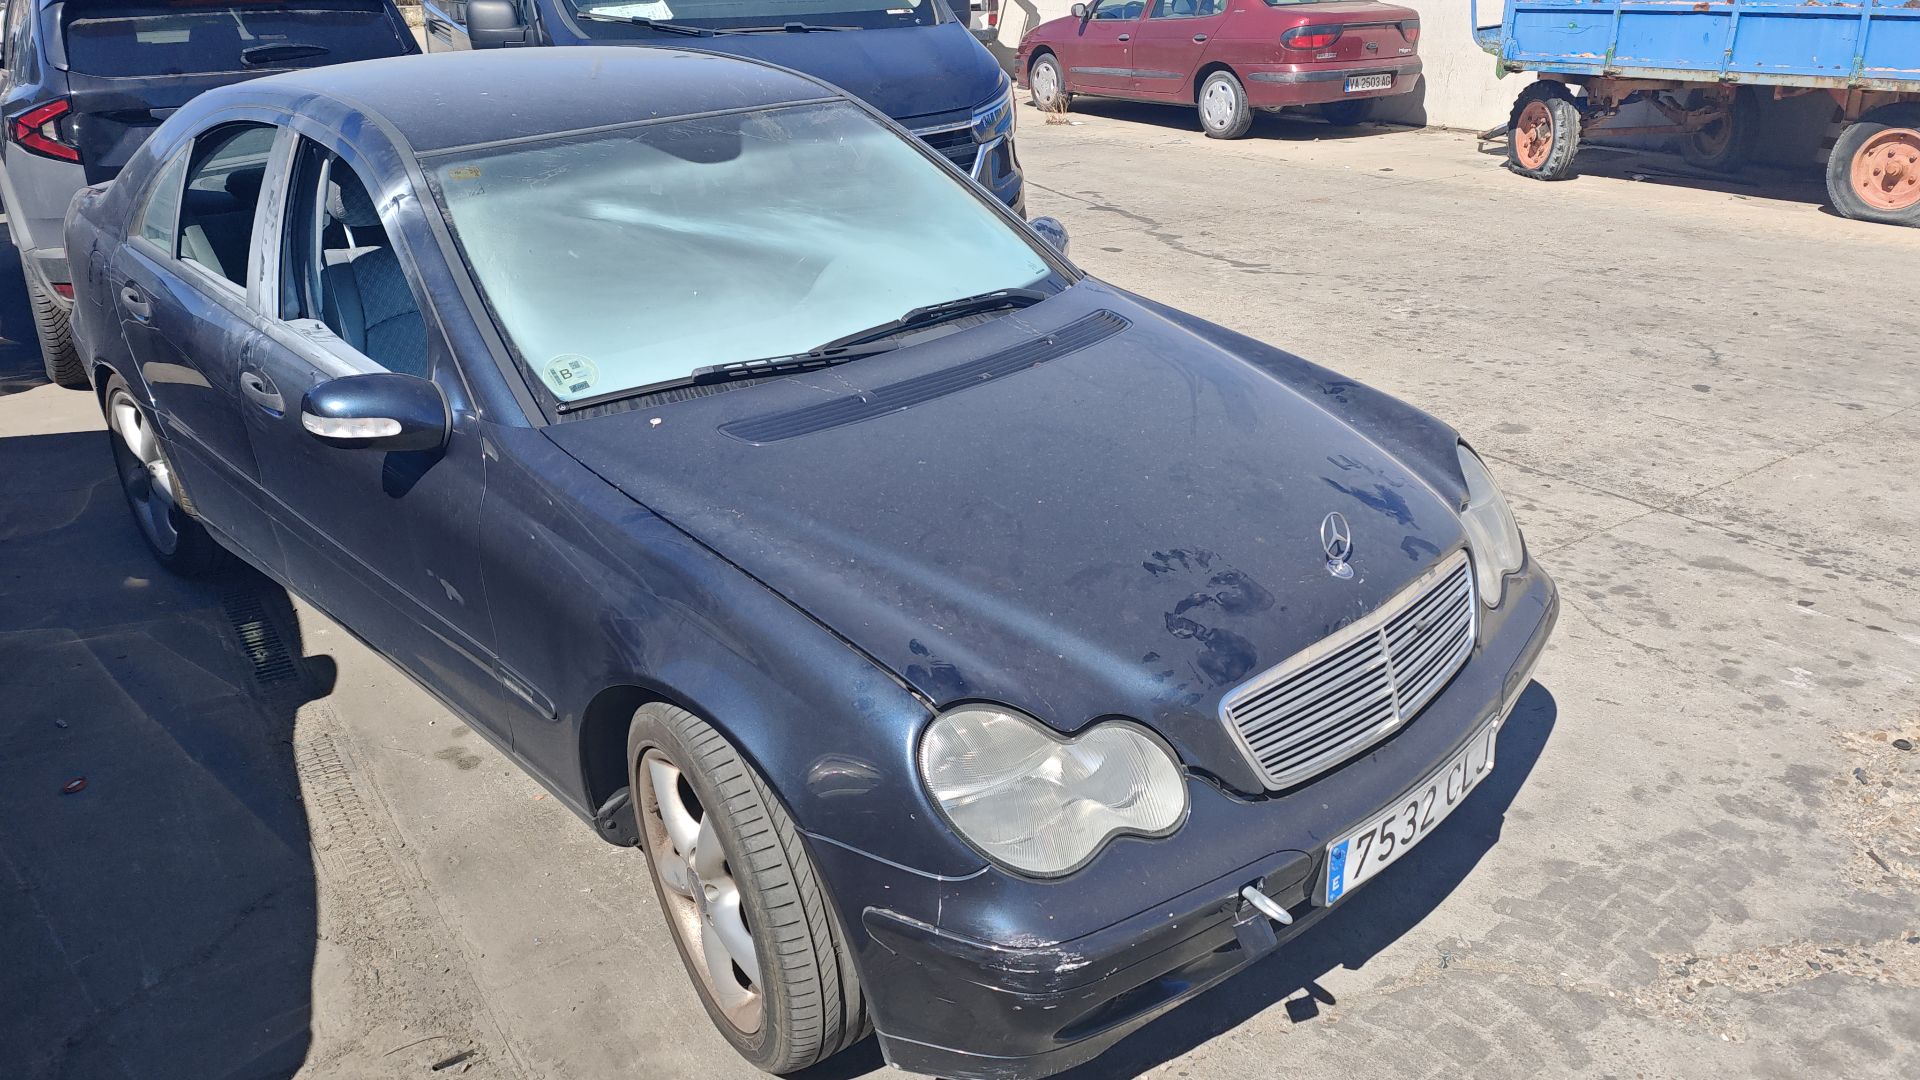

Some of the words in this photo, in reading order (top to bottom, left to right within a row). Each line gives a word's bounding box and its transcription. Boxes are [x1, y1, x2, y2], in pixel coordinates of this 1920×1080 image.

[1350, 78, 1359, 89] VA
[1361, 77, 1380, 88] 2503
[1381, 76, 1390, 86] AG
[560, 368, 573, 380] B
[1353, 785, 1437, 880] 7532
[1446, 728, 1492, 805] CLJ
[1332, 875, 1341, 891] E
